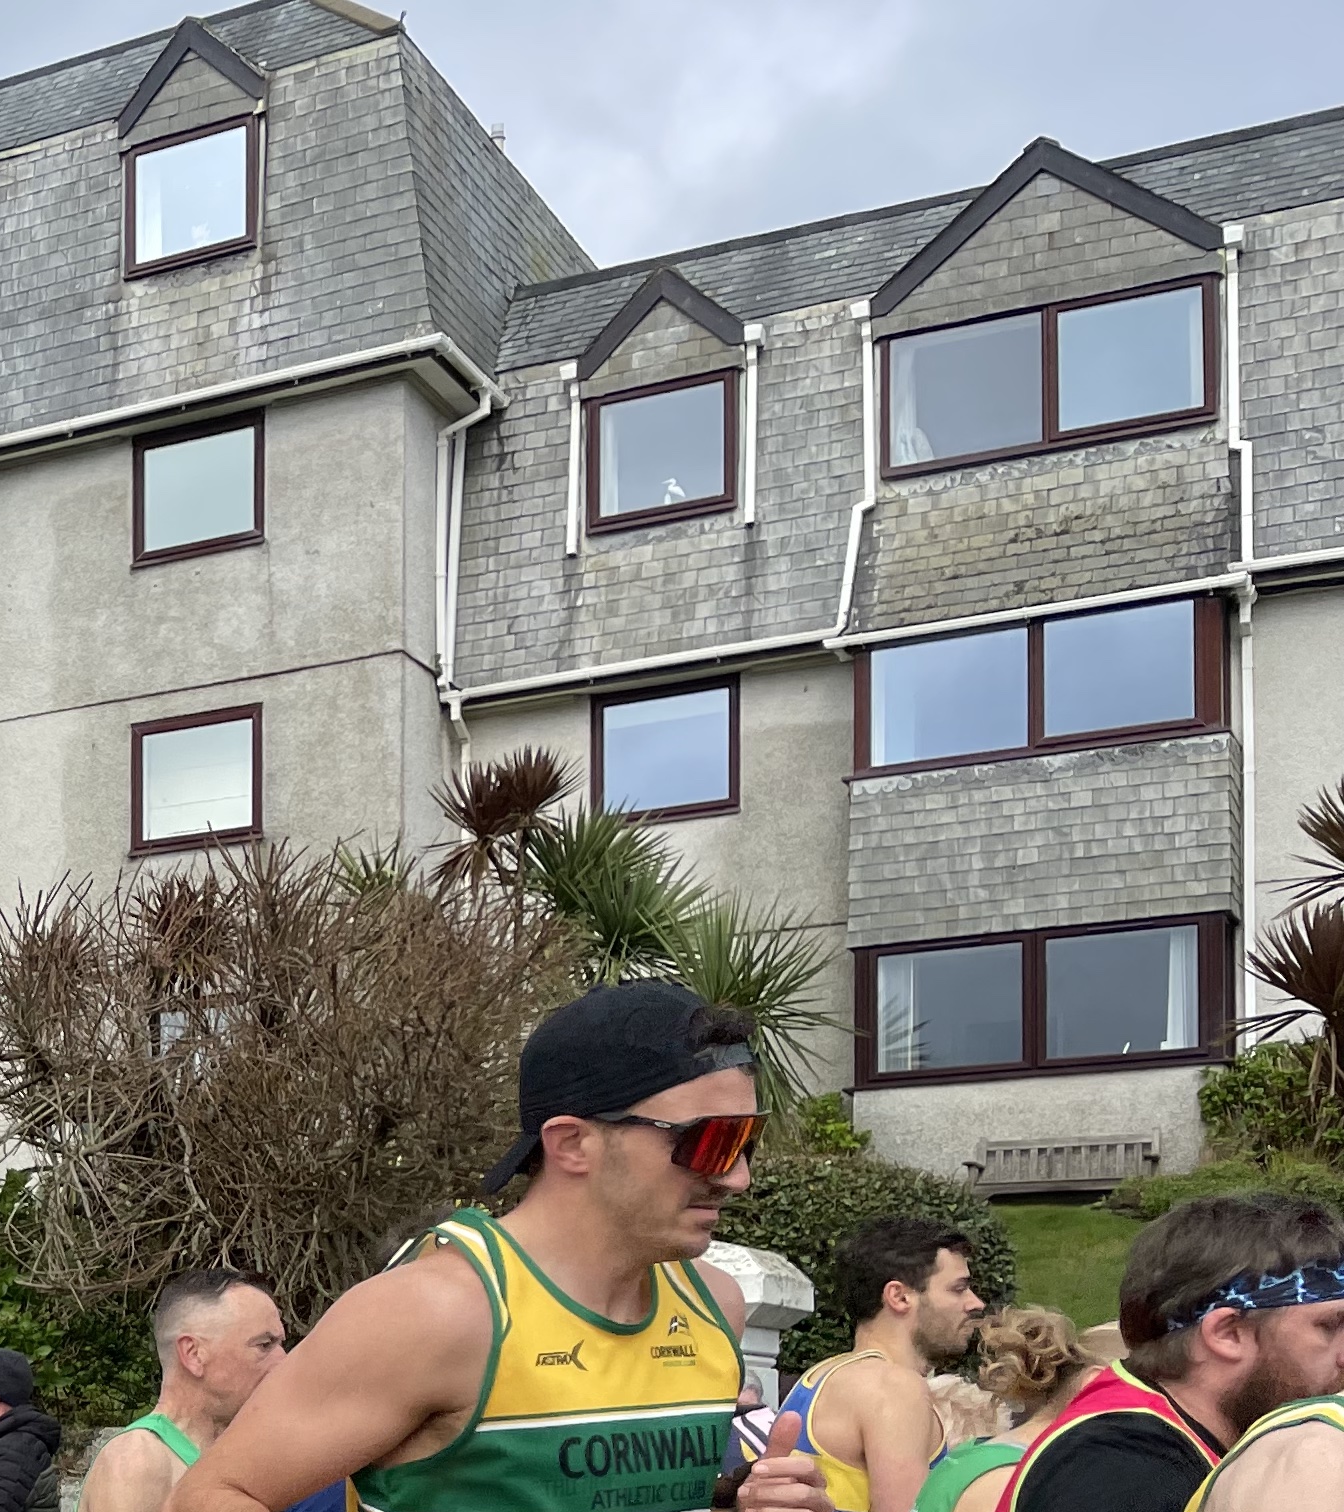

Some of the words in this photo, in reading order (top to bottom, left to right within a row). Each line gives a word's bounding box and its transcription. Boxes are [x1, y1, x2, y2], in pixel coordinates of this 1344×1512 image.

[558, 1424, 722, 1480] CORNWALL
[592, 1485, 667, 1511] ATHLETIC
[669, 1479, 708, 1502] CLUB
